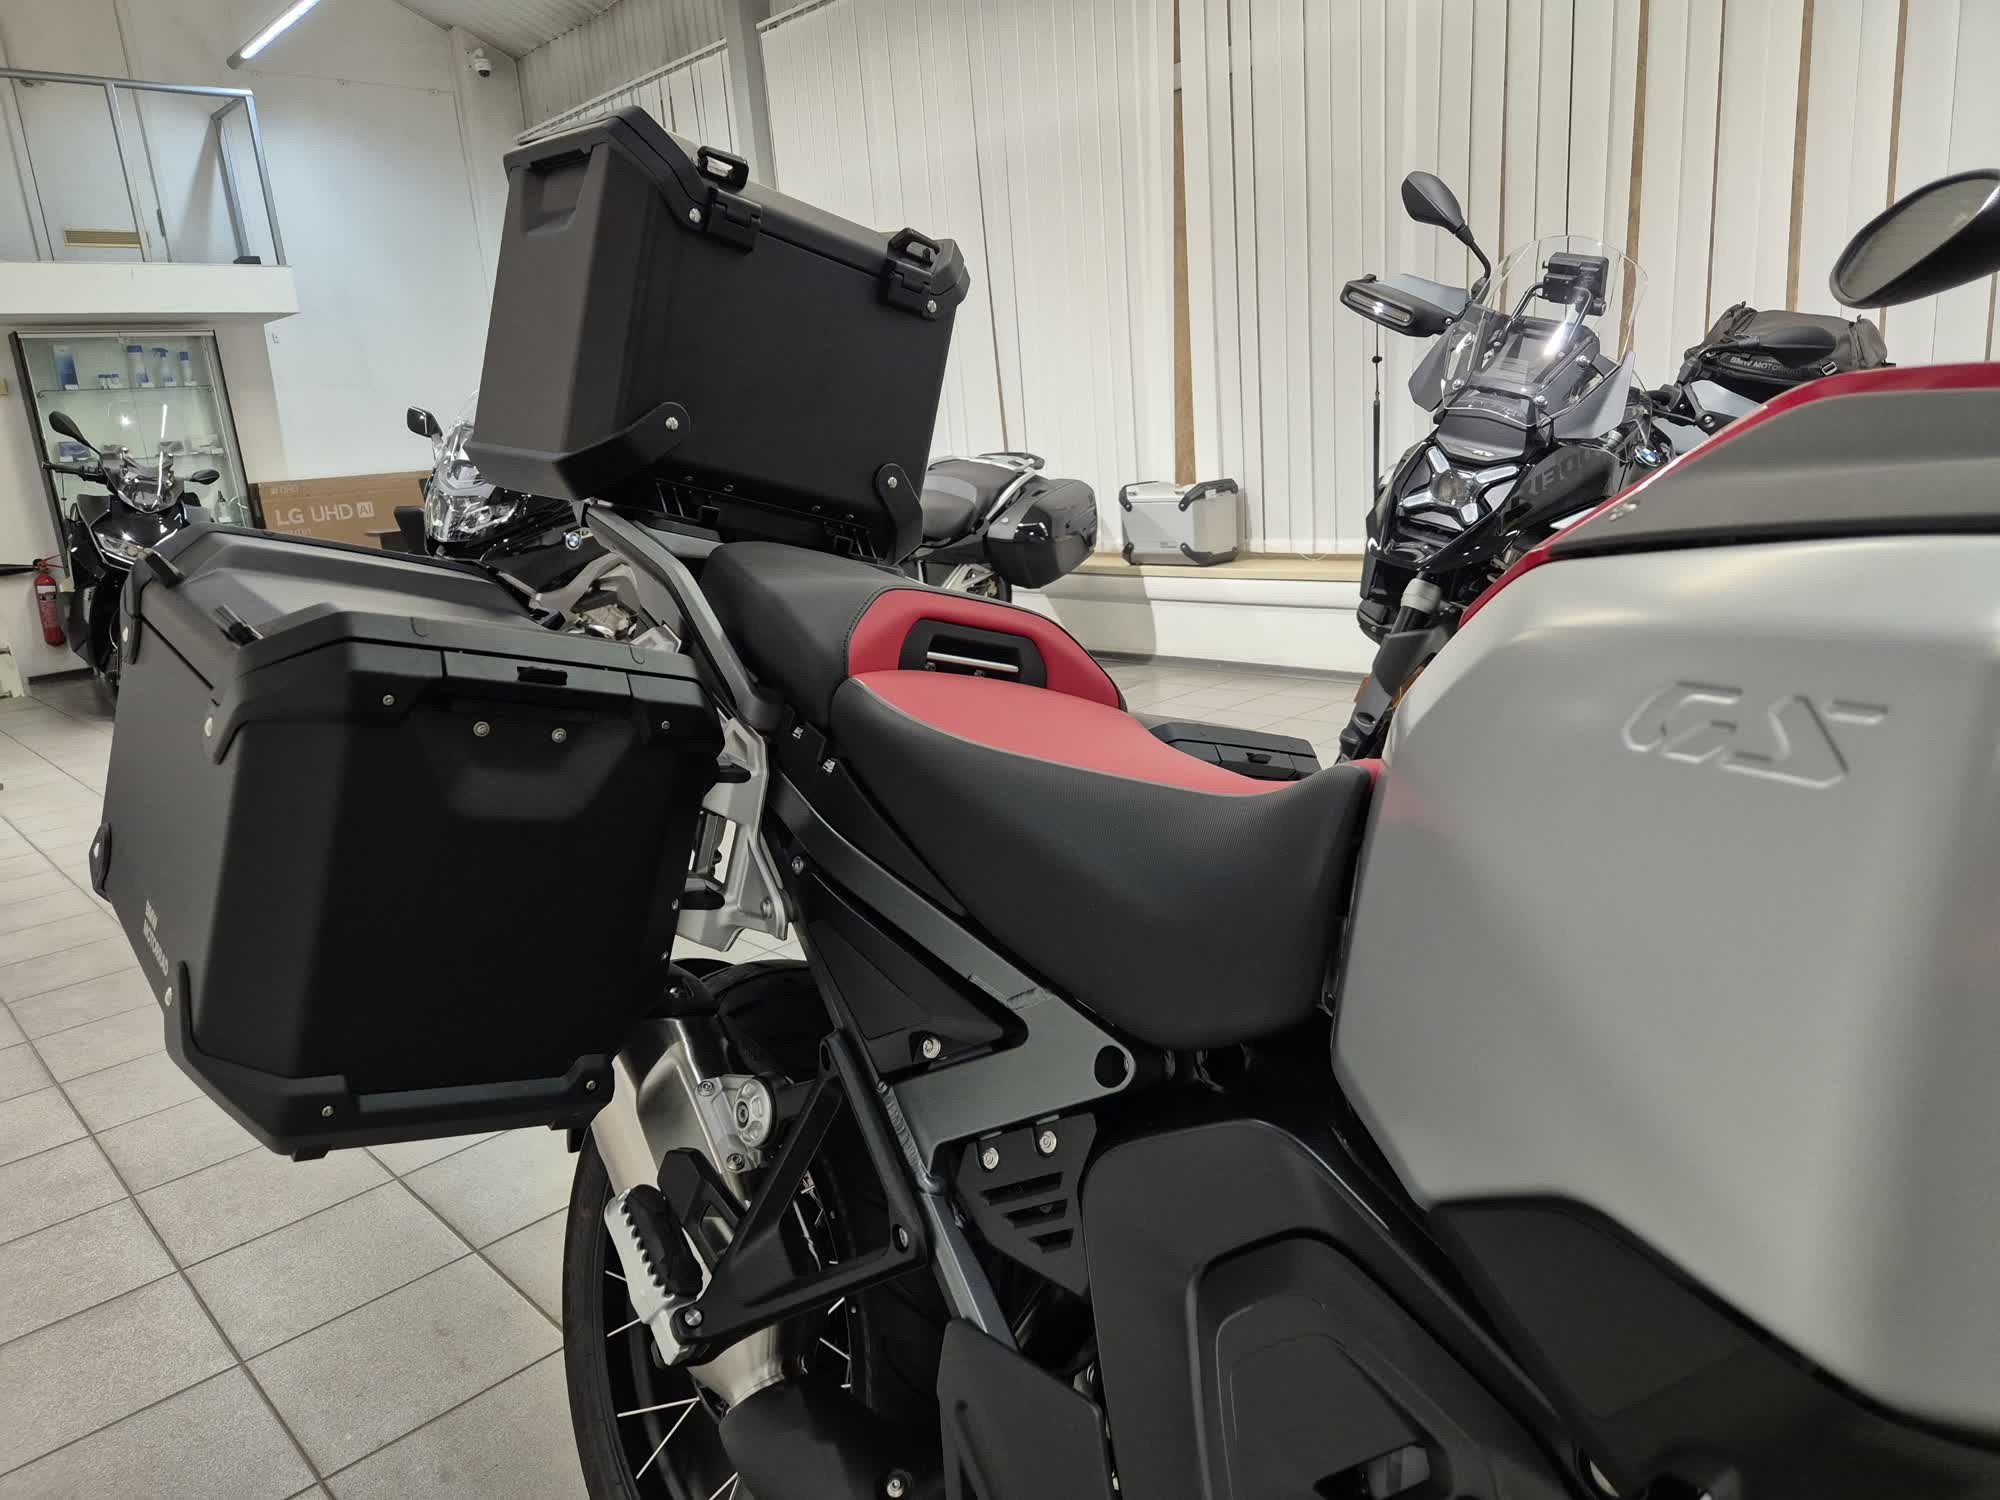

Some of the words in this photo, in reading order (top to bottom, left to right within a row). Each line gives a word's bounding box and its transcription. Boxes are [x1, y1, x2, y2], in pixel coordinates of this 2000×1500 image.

[275, 508, 304, 526] LG
[311, 503, 353, 522] UHD
[357, 501, 375, 518] AI
[1621, 680, 1888, 789] GS
